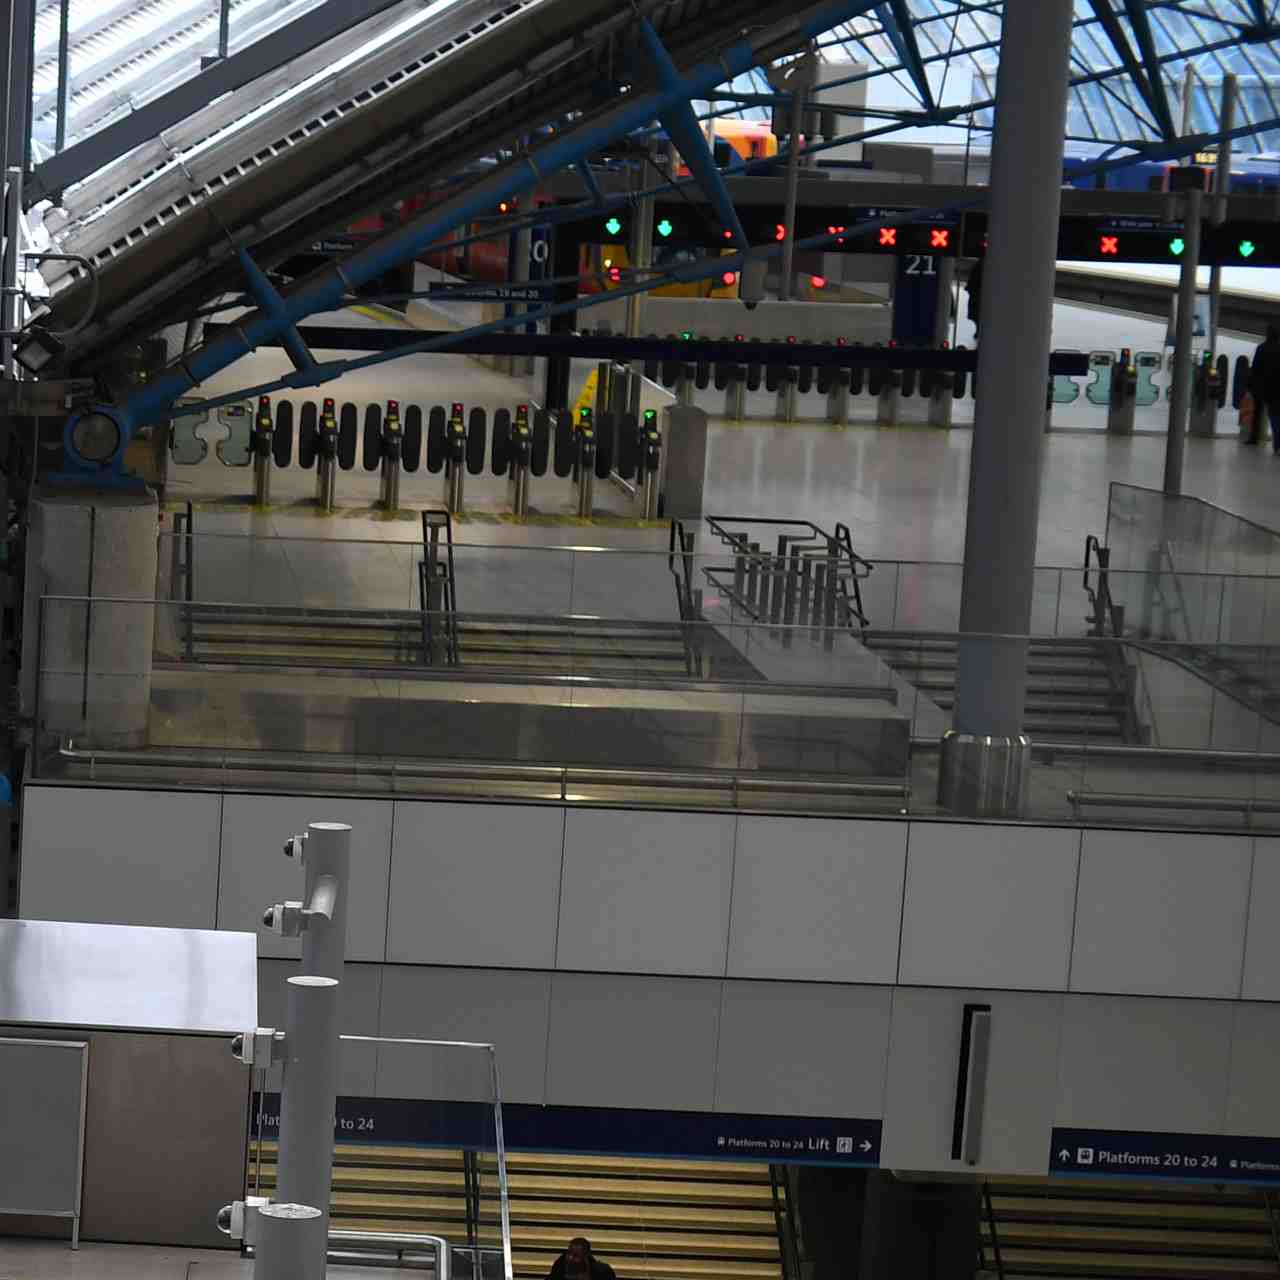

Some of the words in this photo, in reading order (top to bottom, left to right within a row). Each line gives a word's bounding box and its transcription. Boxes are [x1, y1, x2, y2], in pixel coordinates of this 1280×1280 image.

[906, 254, 937, 275] 21
[340, 1118, 354, 1129] to
[357, 1118, 375, 1131] 24
[728, 1137, 768, 1149] Platforms
[769, 1139, 780, 1149] 20
[782, 1140, 791, 1149] to
[792, 1141, 804, 1150] 24
[808, 1138, 830, 1151] Lift
[1098, 1151, 1160, 1166] Platforms
[1163, 1154, 1181, 1167] 20
[1183, 1155, 1198, 1168] to
[1201, 1156, 1218, 1168] 24
